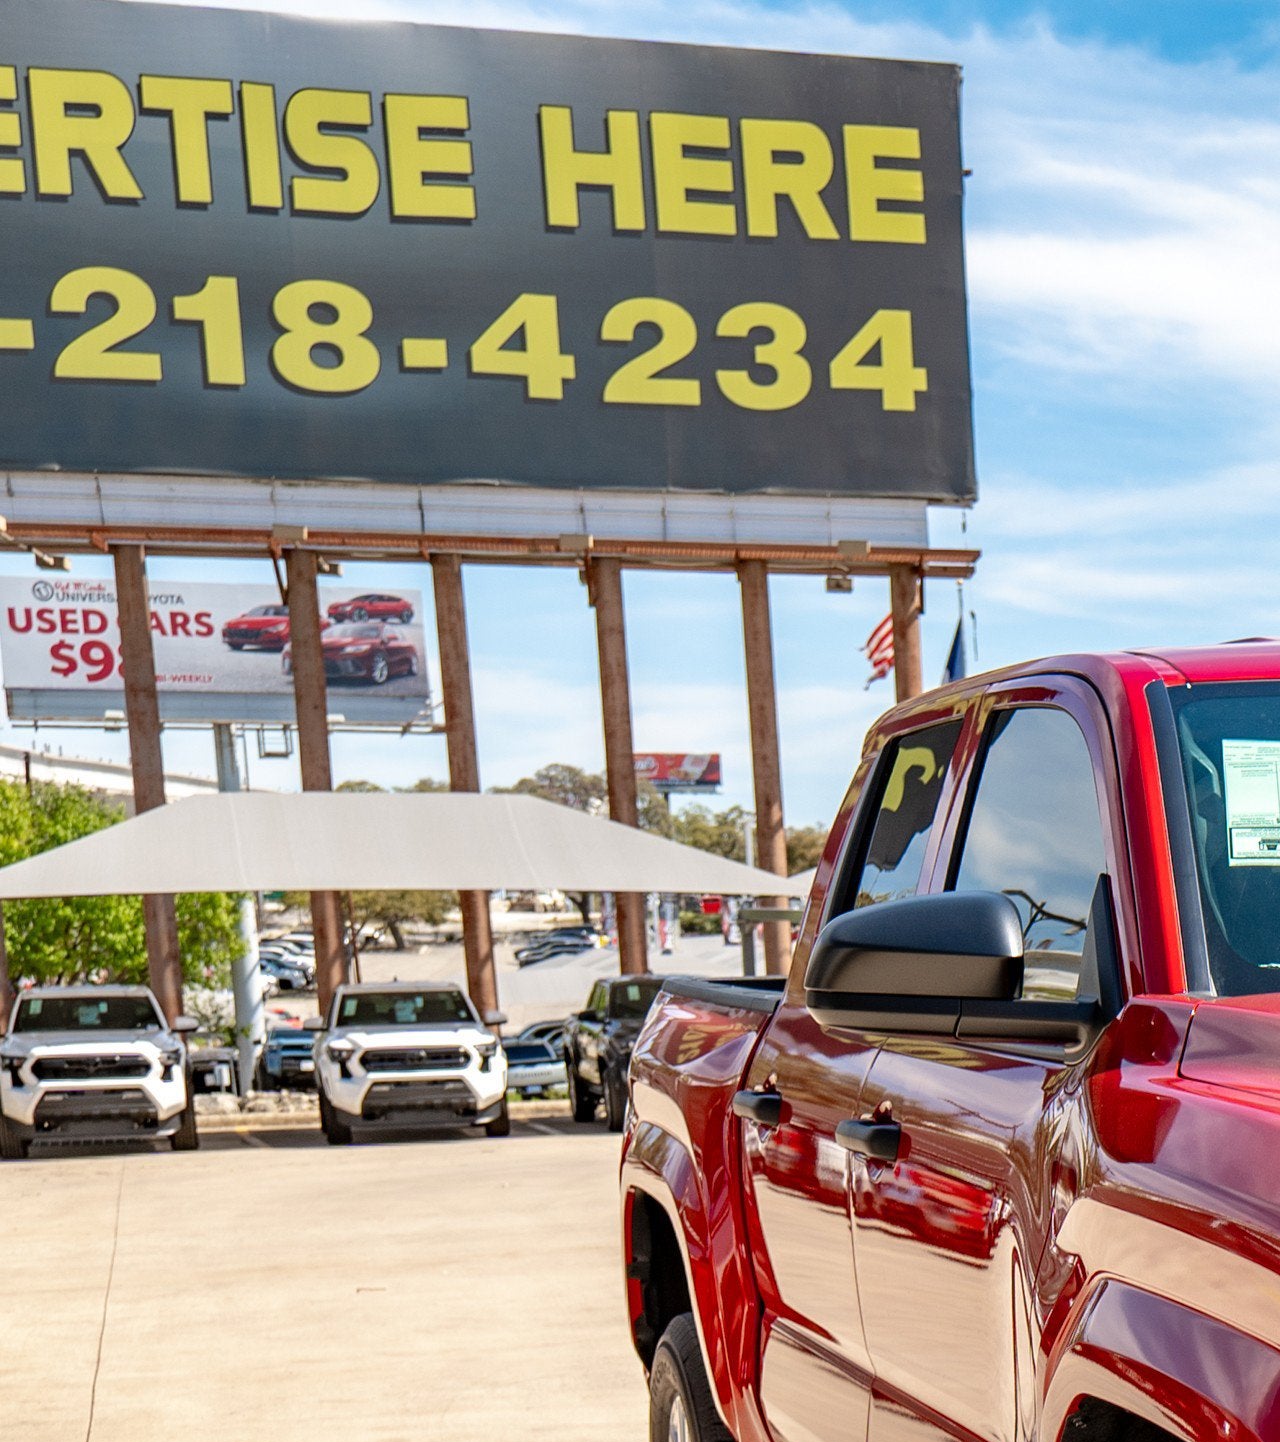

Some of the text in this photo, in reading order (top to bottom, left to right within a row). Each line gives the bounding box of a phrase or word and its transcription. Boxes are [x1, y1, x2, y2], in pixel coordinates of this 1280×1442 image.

[0, 66, 927, 244] RTISE HERE
[56, 591, 185, 605] UNIVERS YOTA
[7, 607, 215, 638] USED ARS
[50, 639, 125, 683] $9
